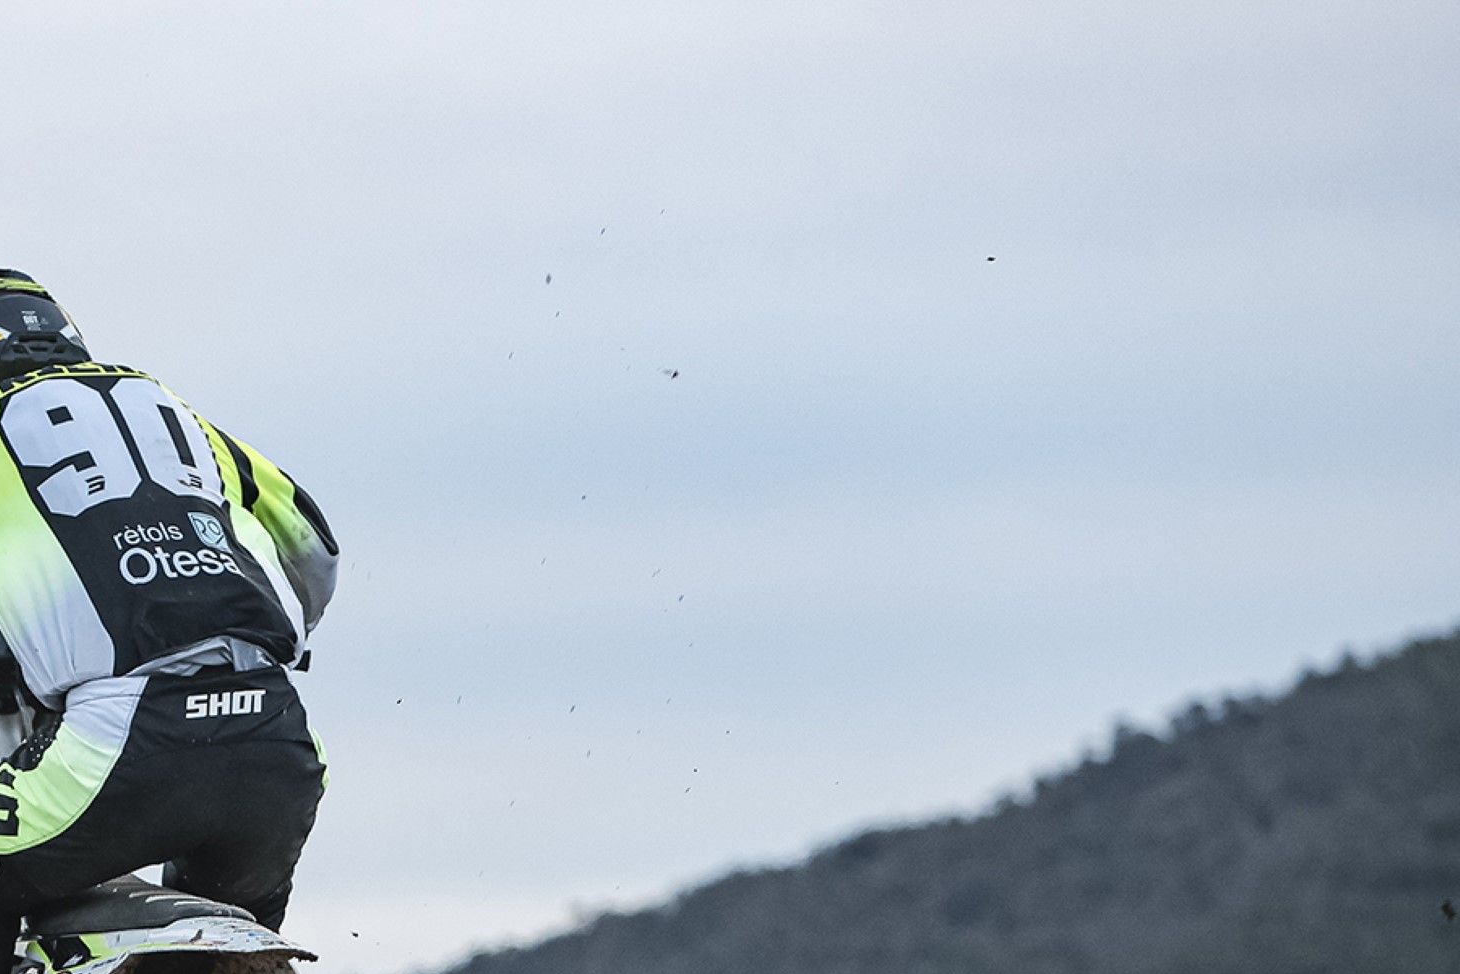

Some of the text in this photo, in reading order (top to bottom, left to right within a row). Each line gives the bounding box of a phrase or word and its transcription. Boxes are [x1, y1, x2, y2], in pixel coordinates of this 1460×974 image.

[0, 377, 226, 517] 90
[113, 521, 184, 550] rètols
[119, 546, 244, 585] Otesa
[185, 689, 267, 719] SHOT
